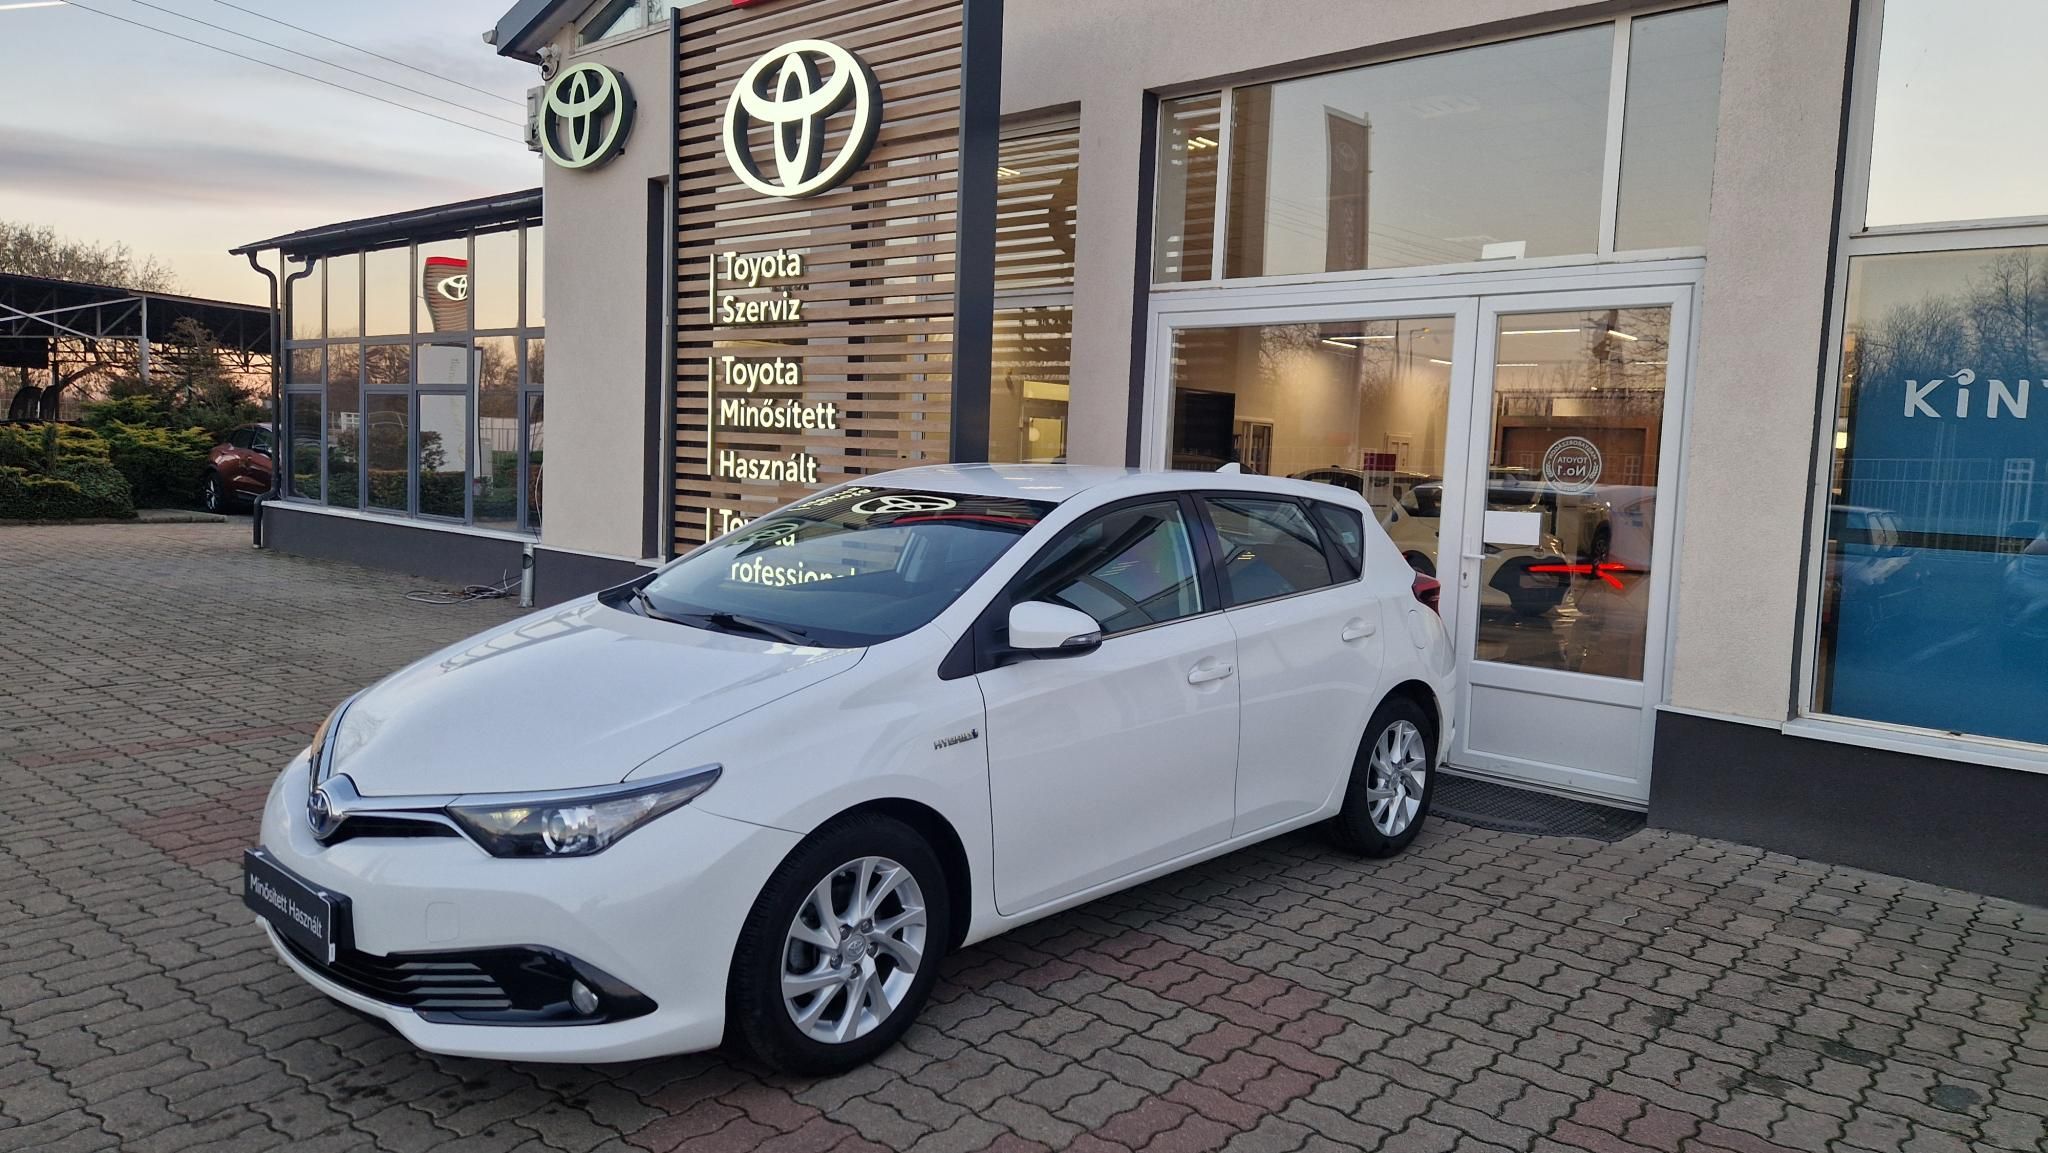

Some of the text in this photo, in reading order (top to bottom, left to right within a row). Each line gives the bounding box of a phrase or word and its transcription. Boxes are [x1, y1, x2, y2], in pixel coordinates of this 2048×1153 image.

[723, 248, 801, 288] Toyota
[722, 290, 801, 323] Szerviz
[721, 355, 798, 393] Toyota
[720, 398, 836, 430] Minősített
[720, 450, 817, 484] Használt
[288, 898, 323, 939] Használt
